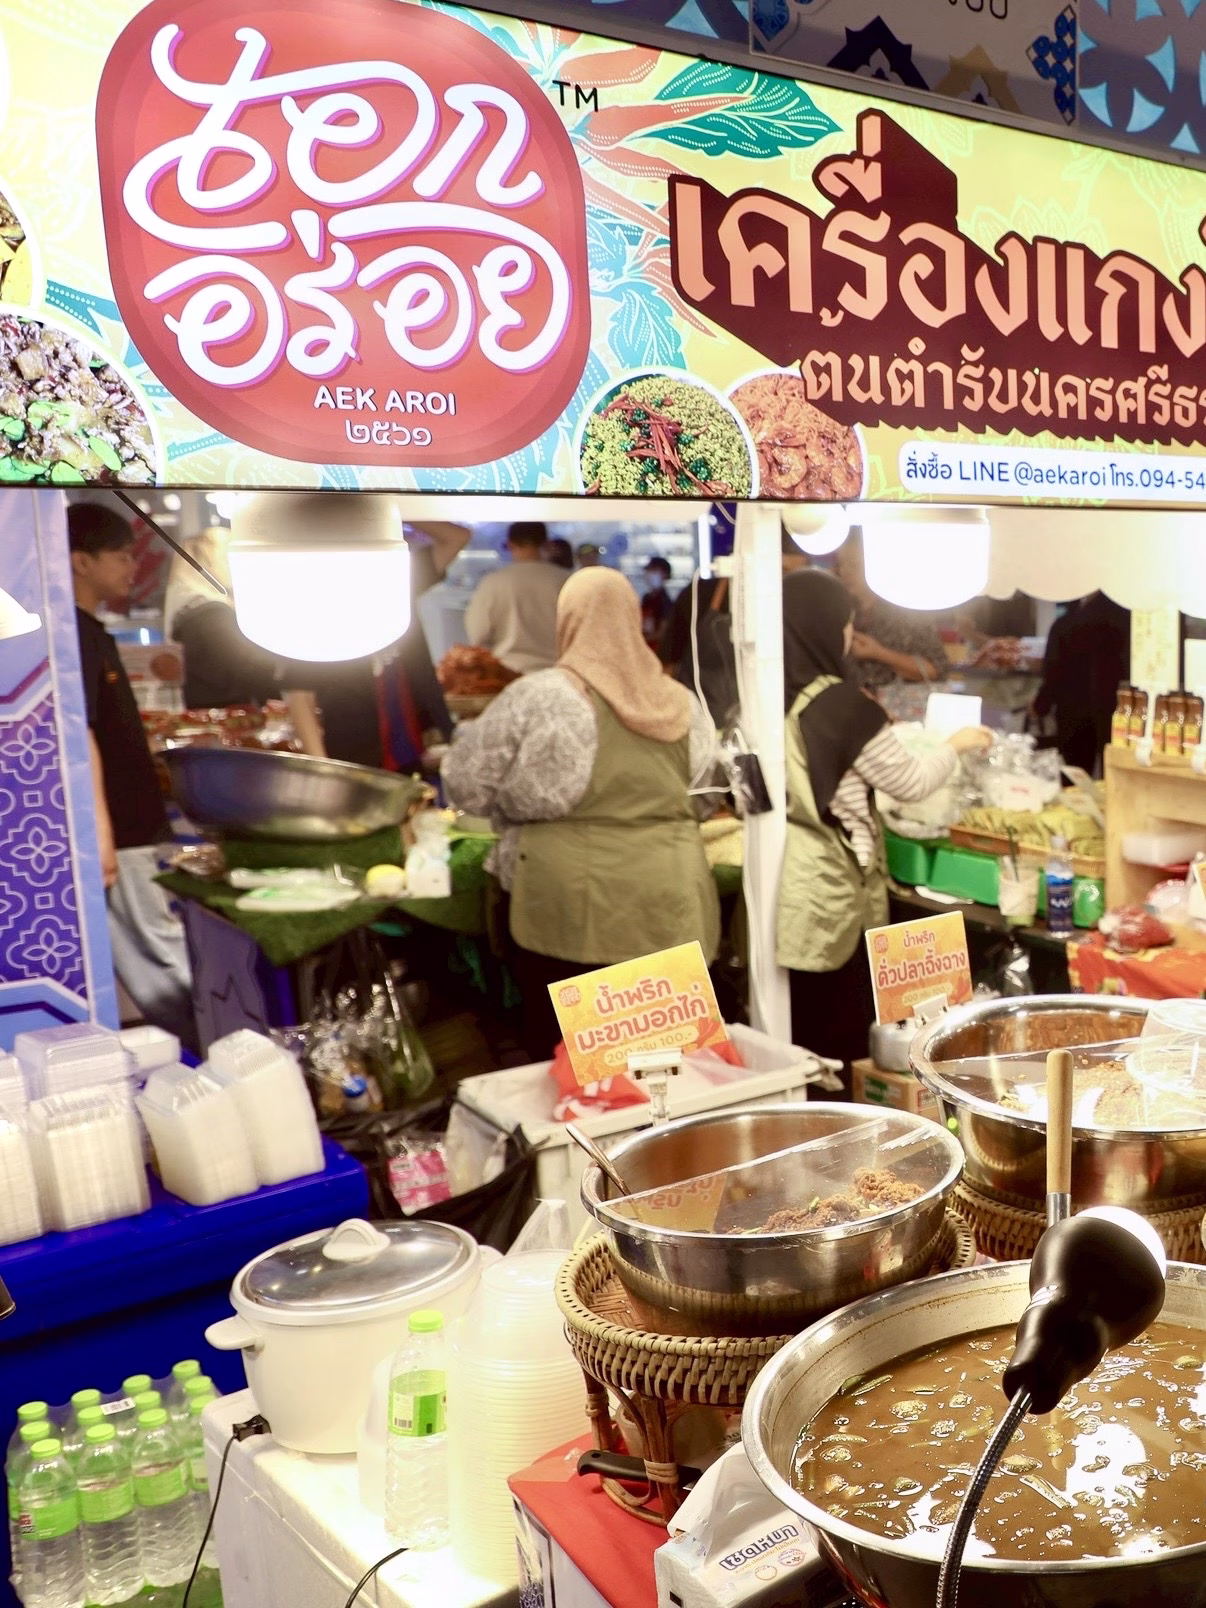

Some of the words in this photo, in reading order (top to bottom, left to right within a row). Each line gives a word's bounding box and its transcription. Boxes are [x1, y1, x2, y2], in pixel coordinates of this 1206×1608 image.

[144, 203, 572, 386] อร่อย
[314, 385, 377, 411] AEK
[384, 389, 456, 416] AROI
[345, 419, 432, 446] ๒๕๖๑
[906, 451, 952, 480] สั่งซื้อ
[959, 460, 1009, 482] LINE
[1014, 461, 1105, 486] @aekaroi
[903, 930, 936, 948] น้ำพริก
[596, 978, 672, 1014] น้ำพริก
[577, 984, 706, 1051] มะขามอกไก่
